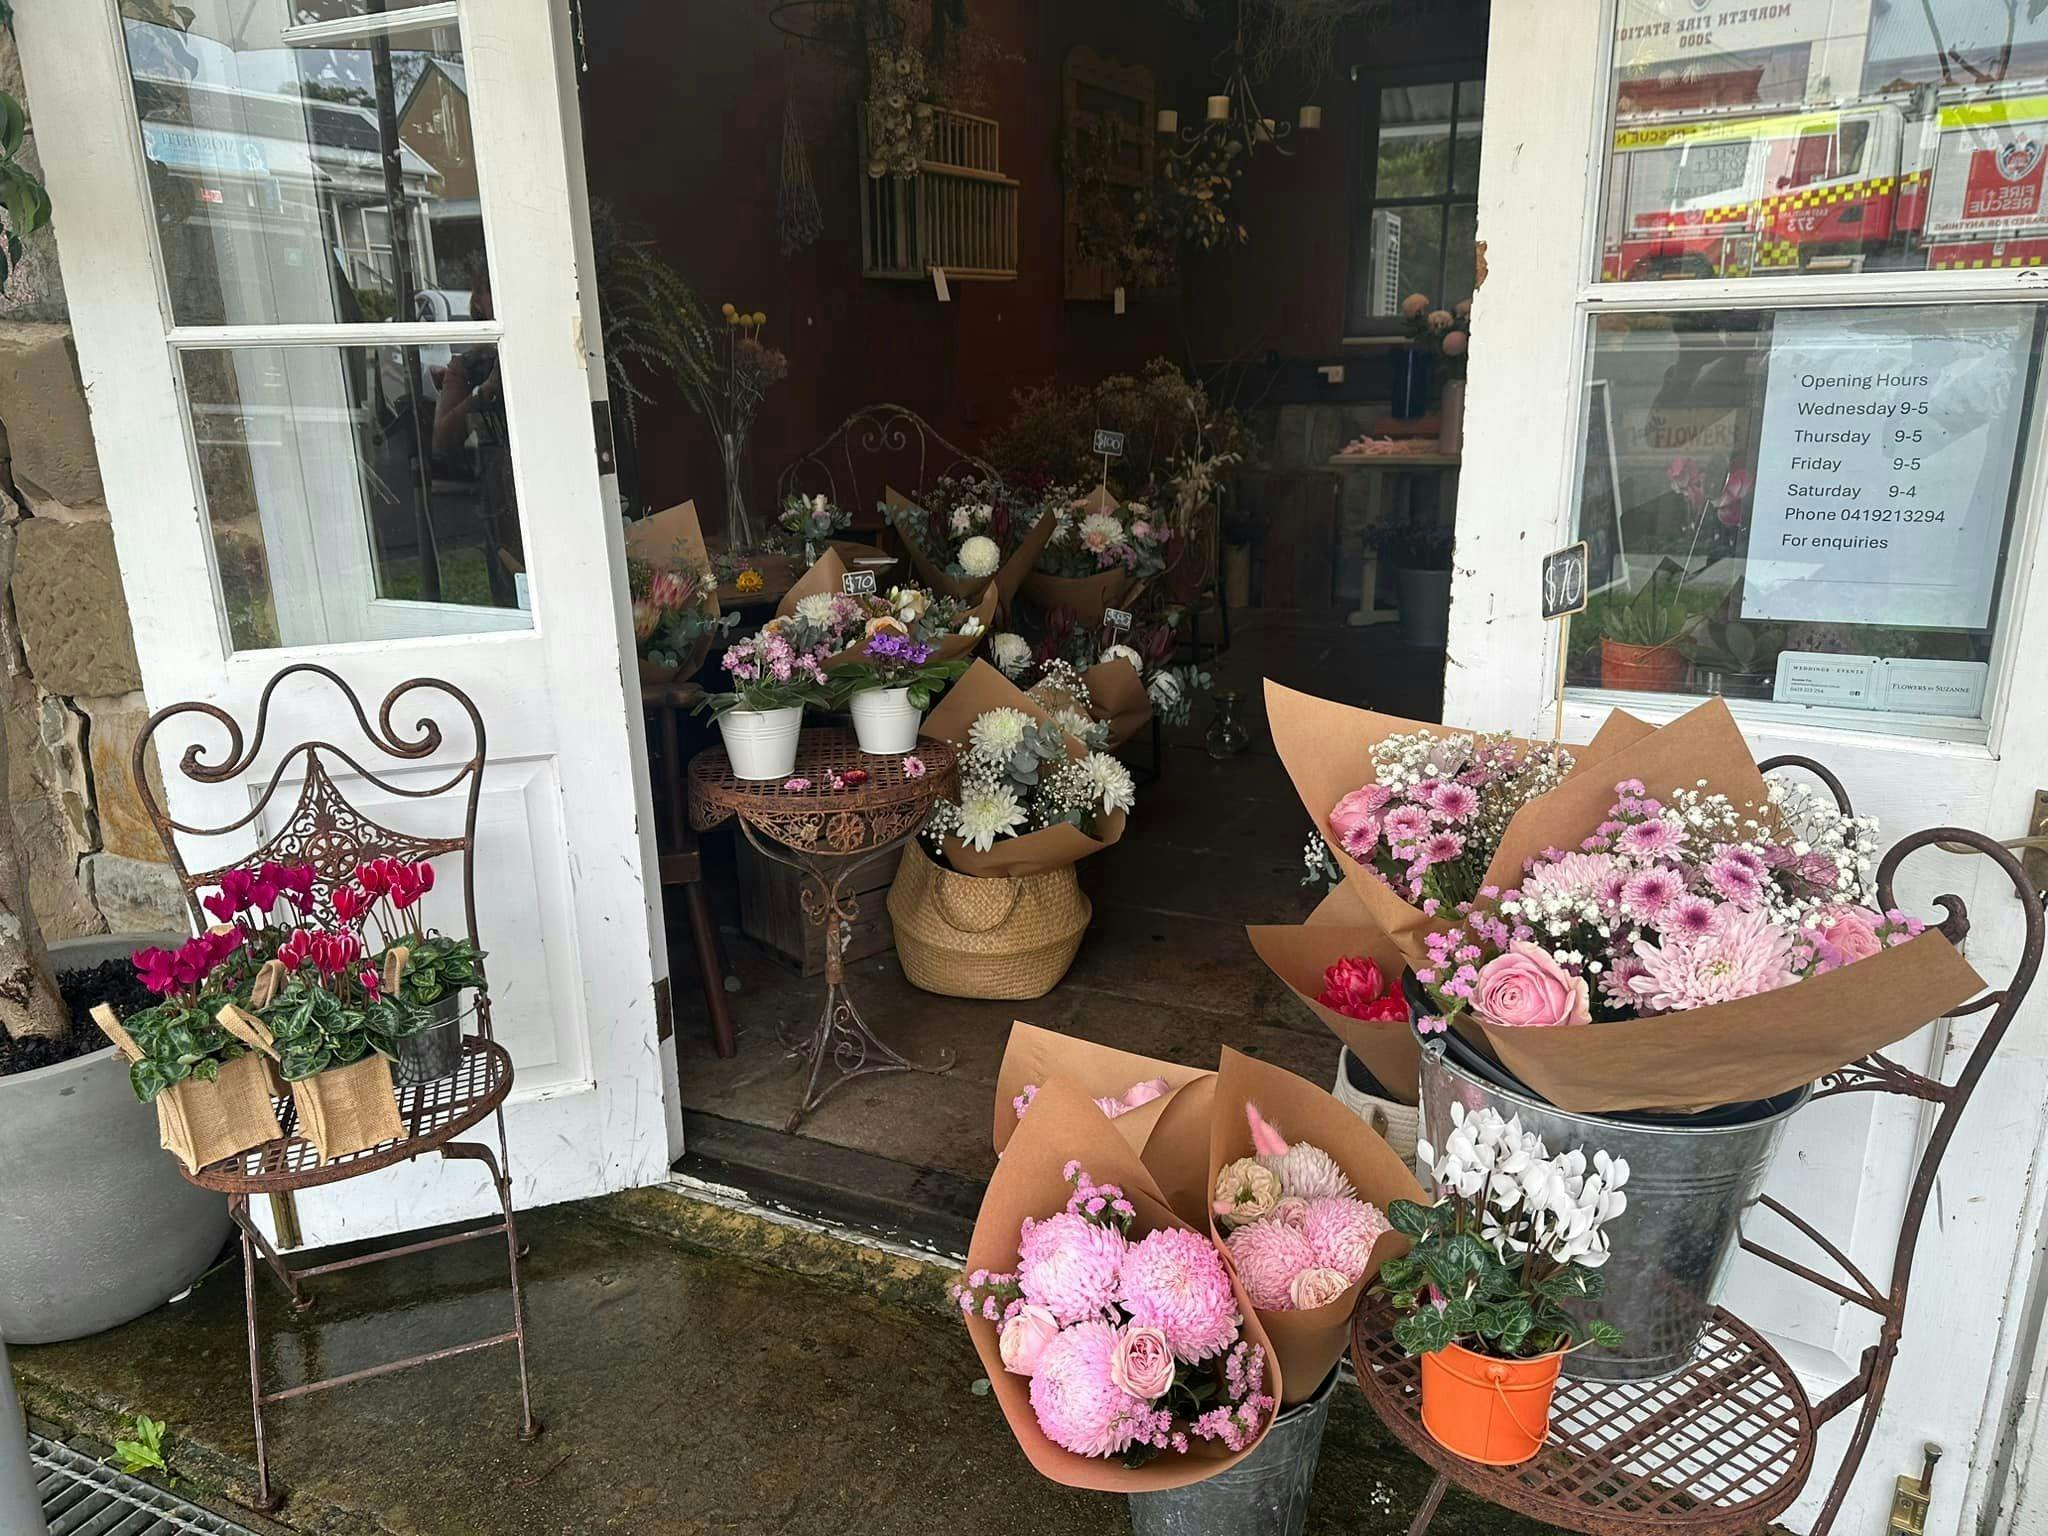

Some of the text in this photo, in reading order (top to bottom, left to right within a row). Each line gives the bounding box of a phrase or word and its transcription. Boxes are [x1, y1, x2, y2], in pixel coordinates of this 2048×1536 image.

[1801, 373, 1929, 390] Opening Hours
[1798, 401, 1929, 418] Wednesday 9-5
[1794, 429, 1923, 446] Thursday 9-5
[1791, 456, 1921, 473] Friday 9-5
[1787, 483, 1917, 500] Saturday 9-4
[1785, 507, 1946, 523] Phone 0419213294
[1781, 533, 1889, 550] For enquiries
[845, 574, 874, 593] $70
[1545, 553, 1582, 612] $70
[1892, 683, 1927, 691] FLOWERS
[1935, 684, 1970, 694] SUZANNE
